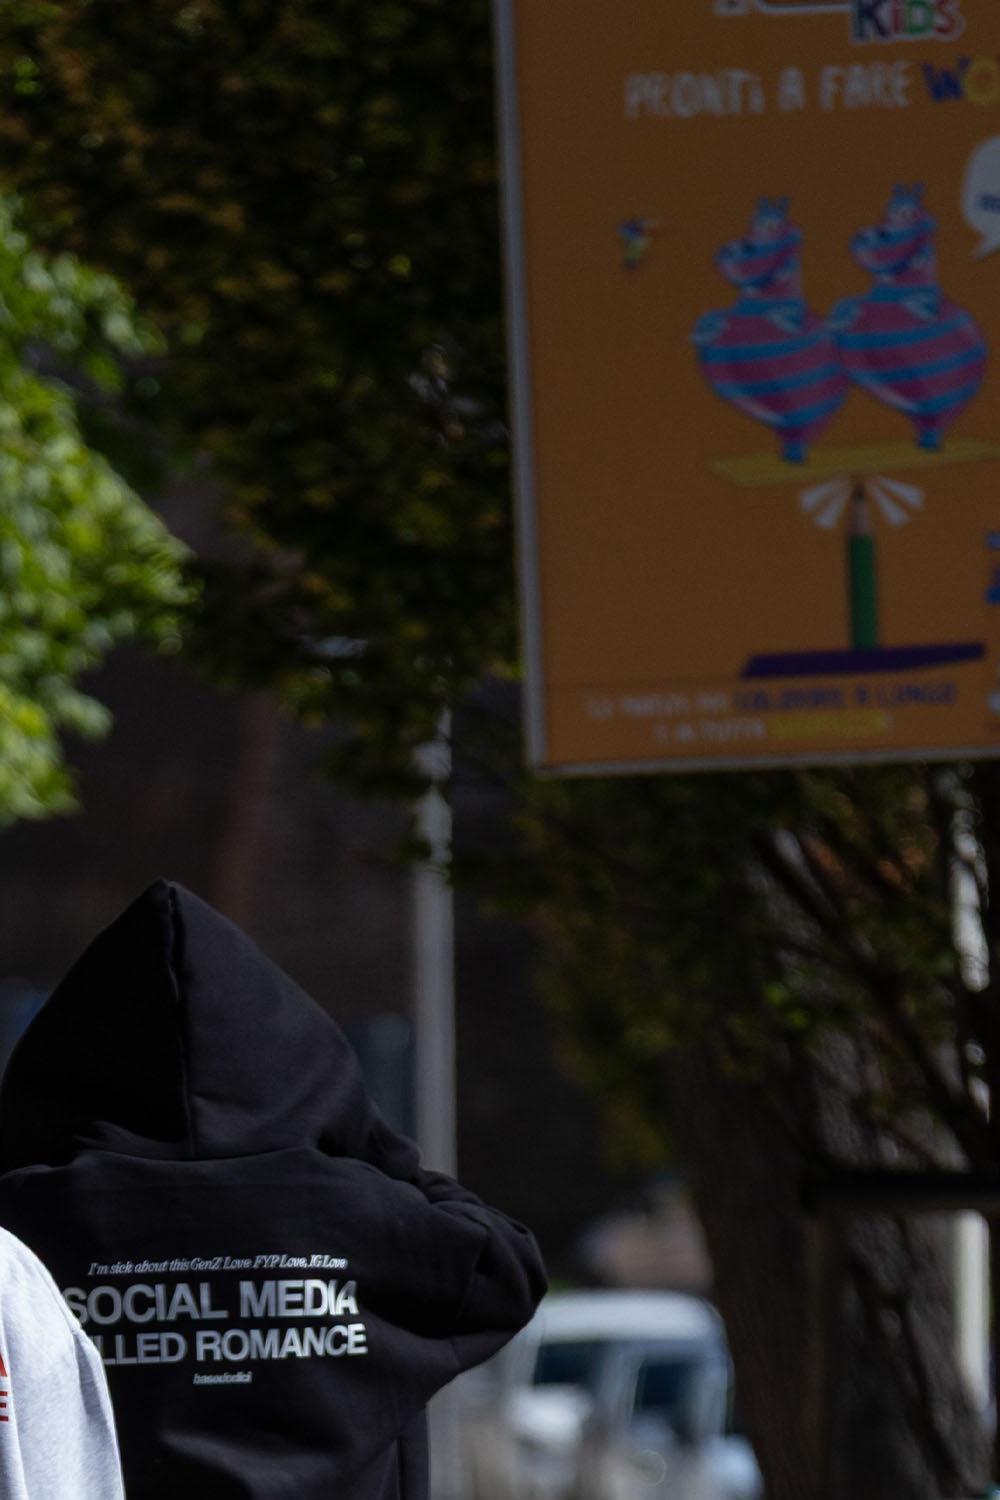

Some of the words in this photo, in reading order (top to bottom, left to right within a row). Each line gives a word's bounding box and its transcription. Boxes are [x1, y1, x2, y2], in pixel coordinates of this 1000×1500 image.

[778, 66, 805, 111] A
[819, 61, 912, 110] FARE
[88, 1261, 108, 1276] I'm
[109, 1260, 132, 1275] sick
[134, 1258, 168, 1274] about
[169, 1257, 190, 1272] this
[222, 1255, 252, 1271] Love
[252, 1254, 280, 1269] FYP
[279, 1253, 307, 1269] Love,
[307, 1254, 321, 1269] IG
[321, 1254, 347, 1269] Love
[63, 1282, 228, 1325] SOCIAL
[240, 1278, 359, 1317] MEDIA
[195, 1323, 369, 1362] ROMANCE
